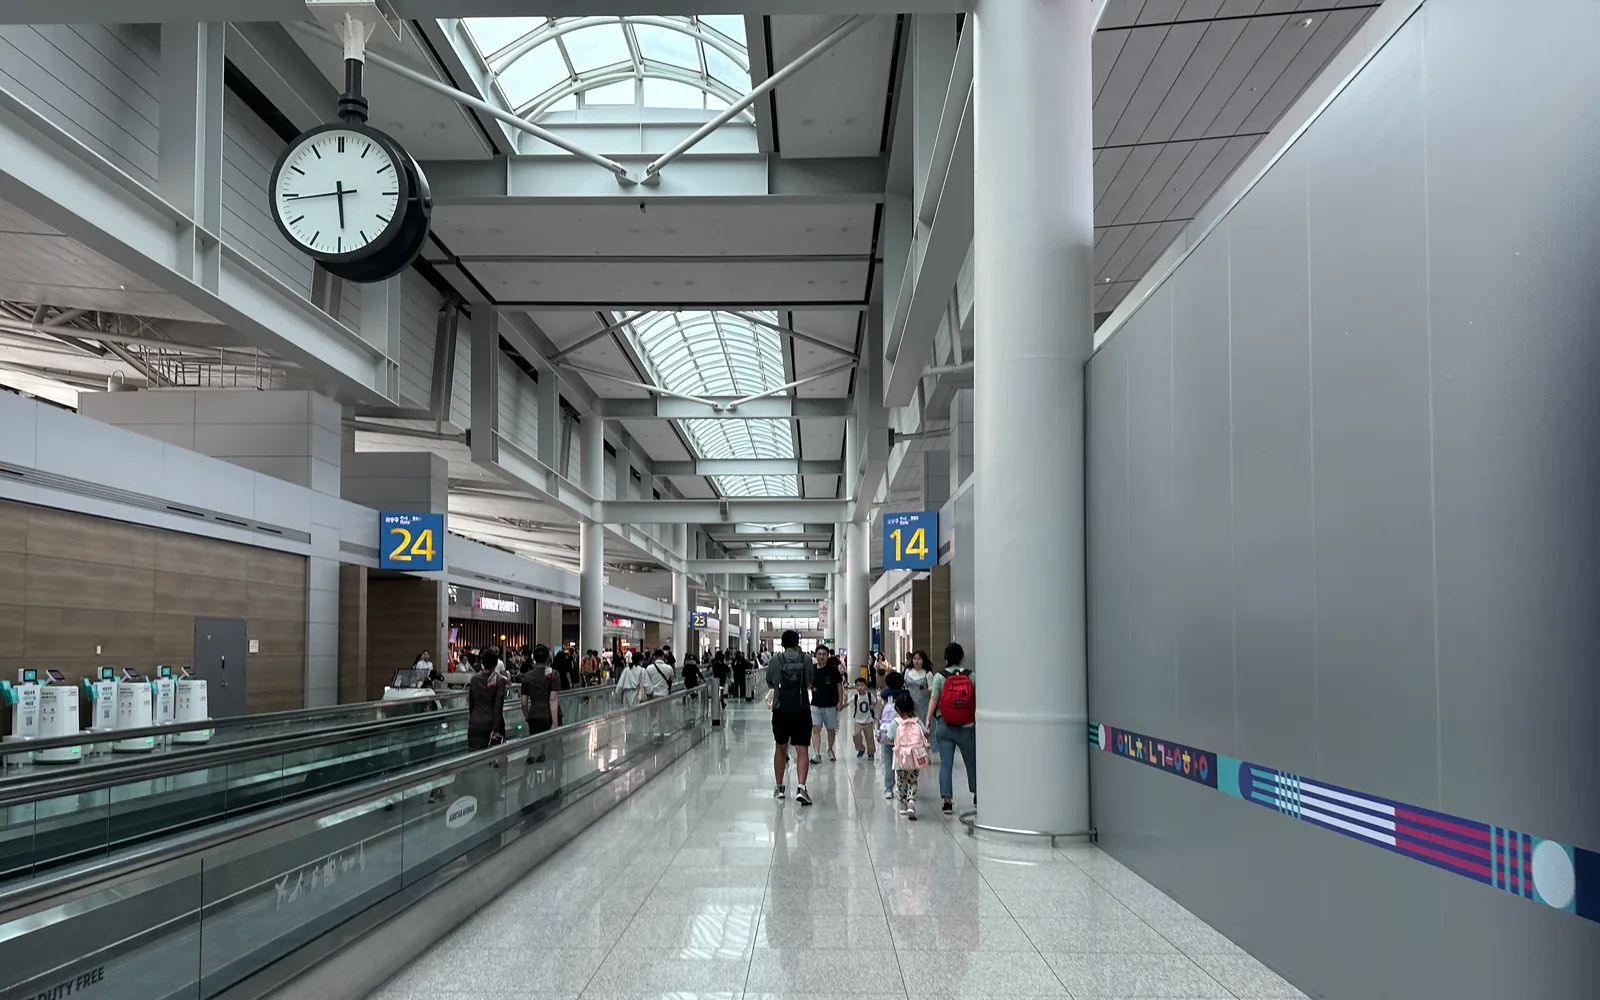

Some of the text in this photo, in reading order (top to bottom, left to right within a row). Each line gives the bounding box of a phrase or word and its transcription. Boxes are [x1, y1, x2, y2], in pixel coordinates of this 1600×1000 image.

[389, 527, 436, 561] 24
[889, 528, 929, 561] 14
[693, 615, 706, 627] 23
[37, 966, 105, 1000] DUTY FREE
